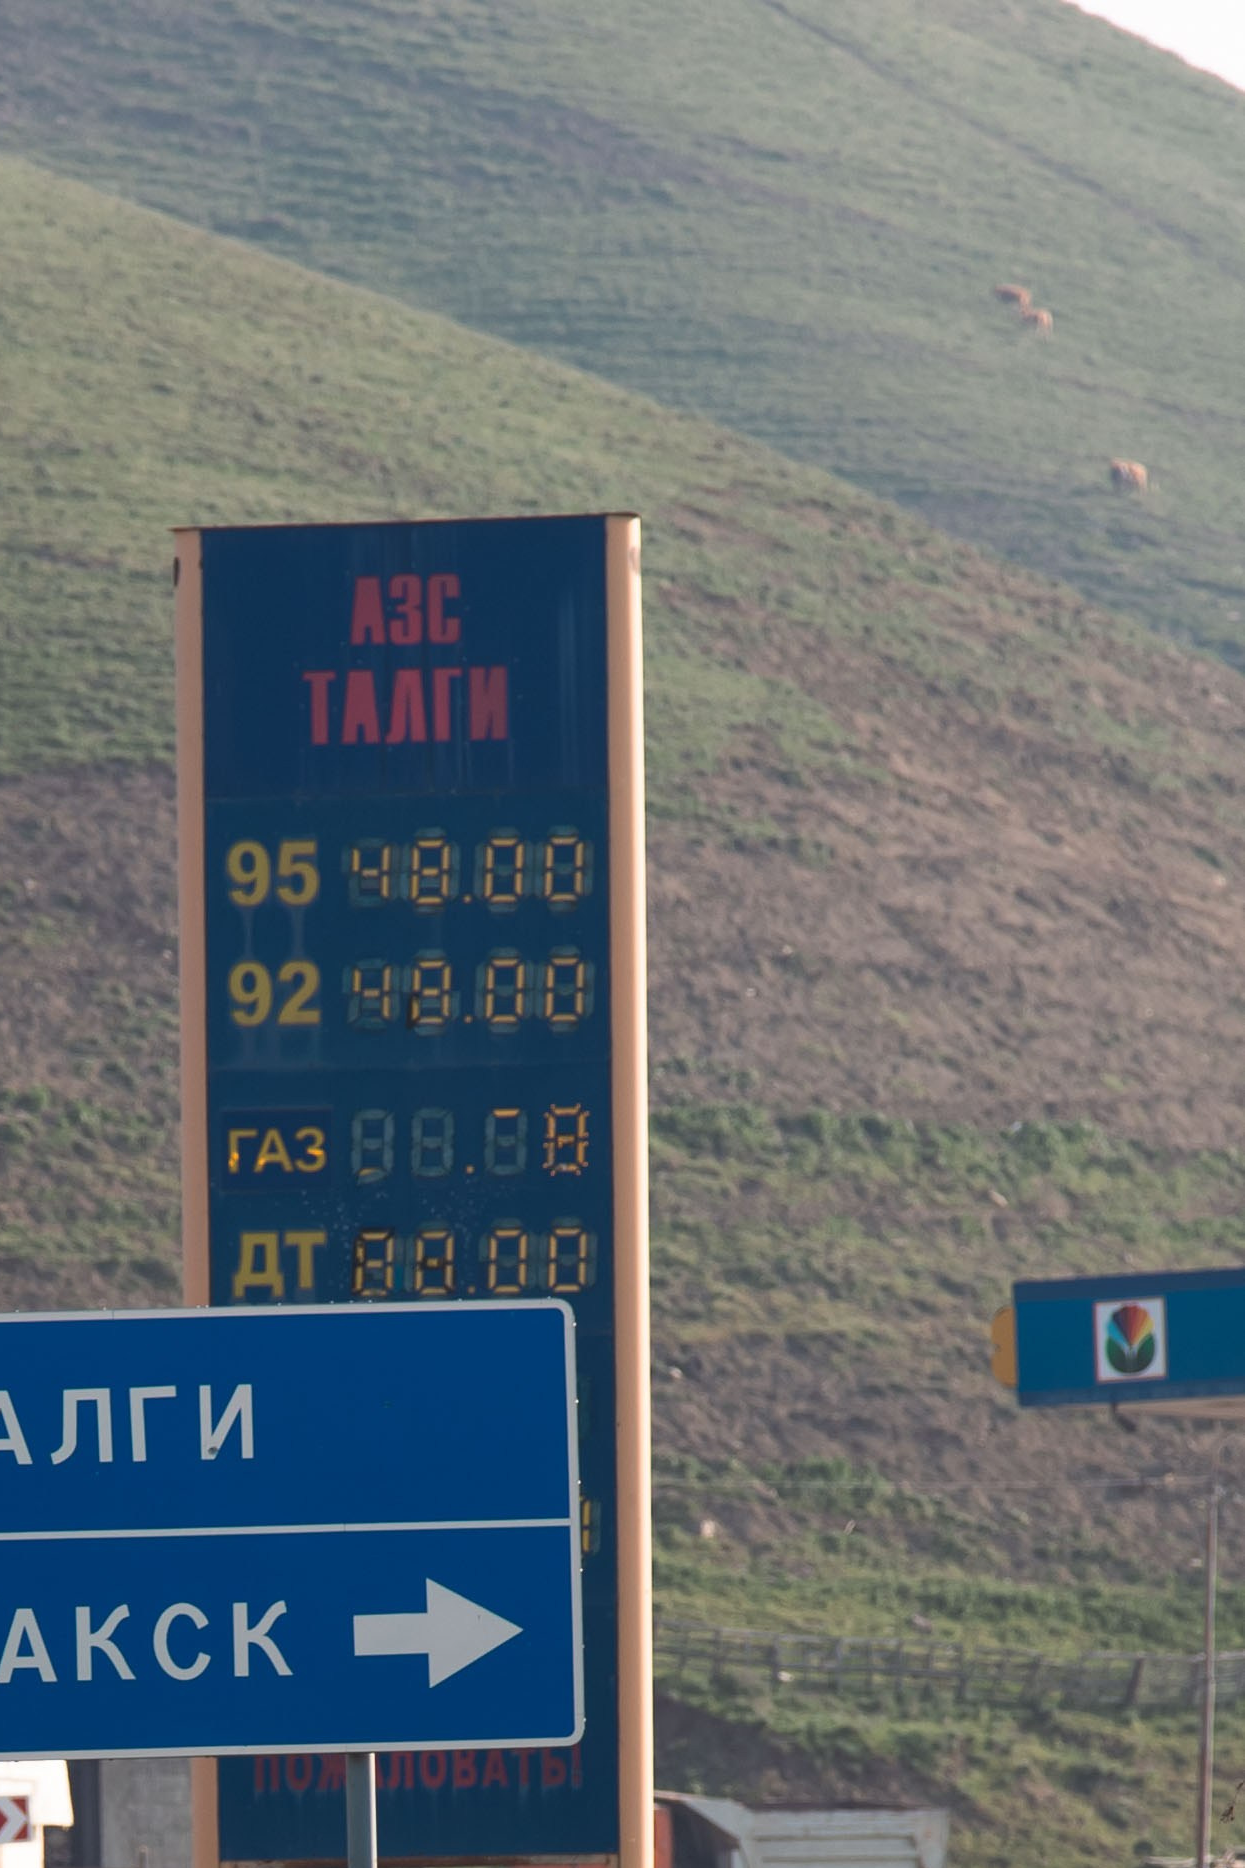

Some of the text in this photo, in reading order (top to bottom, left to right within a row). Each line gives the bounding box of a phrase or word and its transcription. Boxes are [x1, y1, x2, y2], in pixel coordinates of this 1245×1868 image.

[350, 573, 461, 645] АЗС
[301, 666, 509, 745] ТАЛГИ
[226, 838, 320, 906] 95
[228, 960, 321, 1027] 92
[227, 1127, 328, 1175] ГАЗ
[231, 1230, 328, 1299] ДТ
[255, 1748, 583, 1793] ПОЖЛОВАТЬ!
